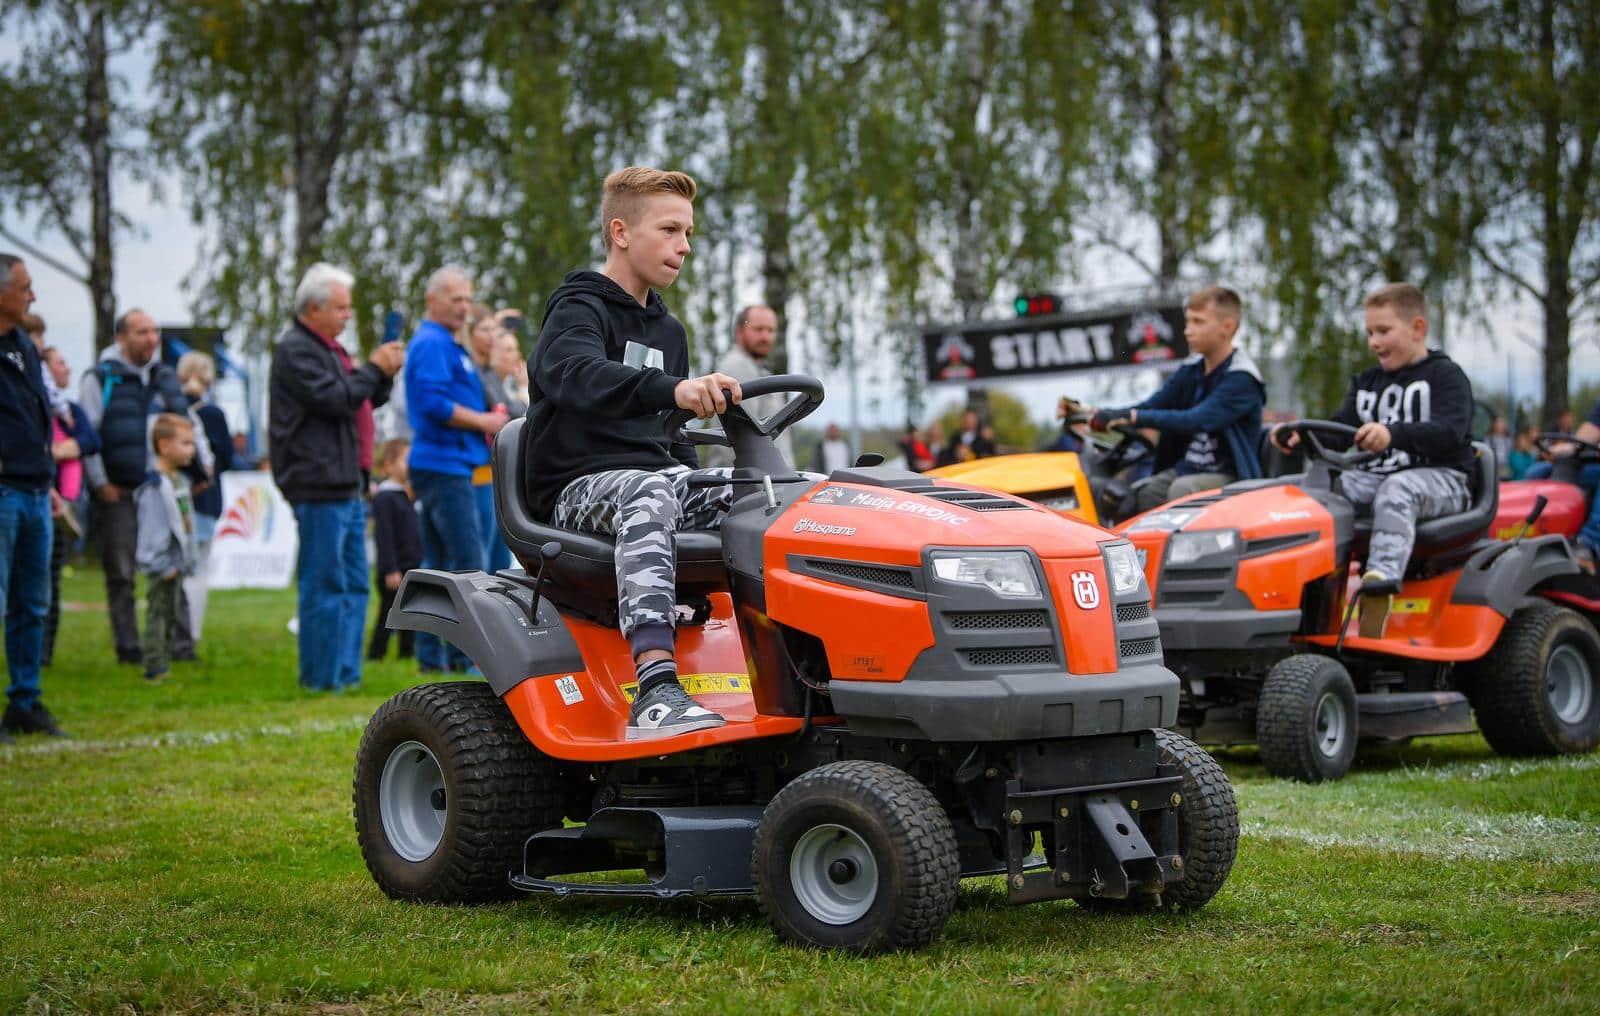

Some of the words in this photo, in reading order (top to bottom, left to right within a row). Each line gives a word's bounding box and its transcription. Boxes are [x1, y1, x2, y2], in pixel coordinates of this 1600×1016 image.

[990, 324, 1114, 370] START
[850, 492, 896, 512] Matija
[804, 520, 857, 537] Husqvarna
